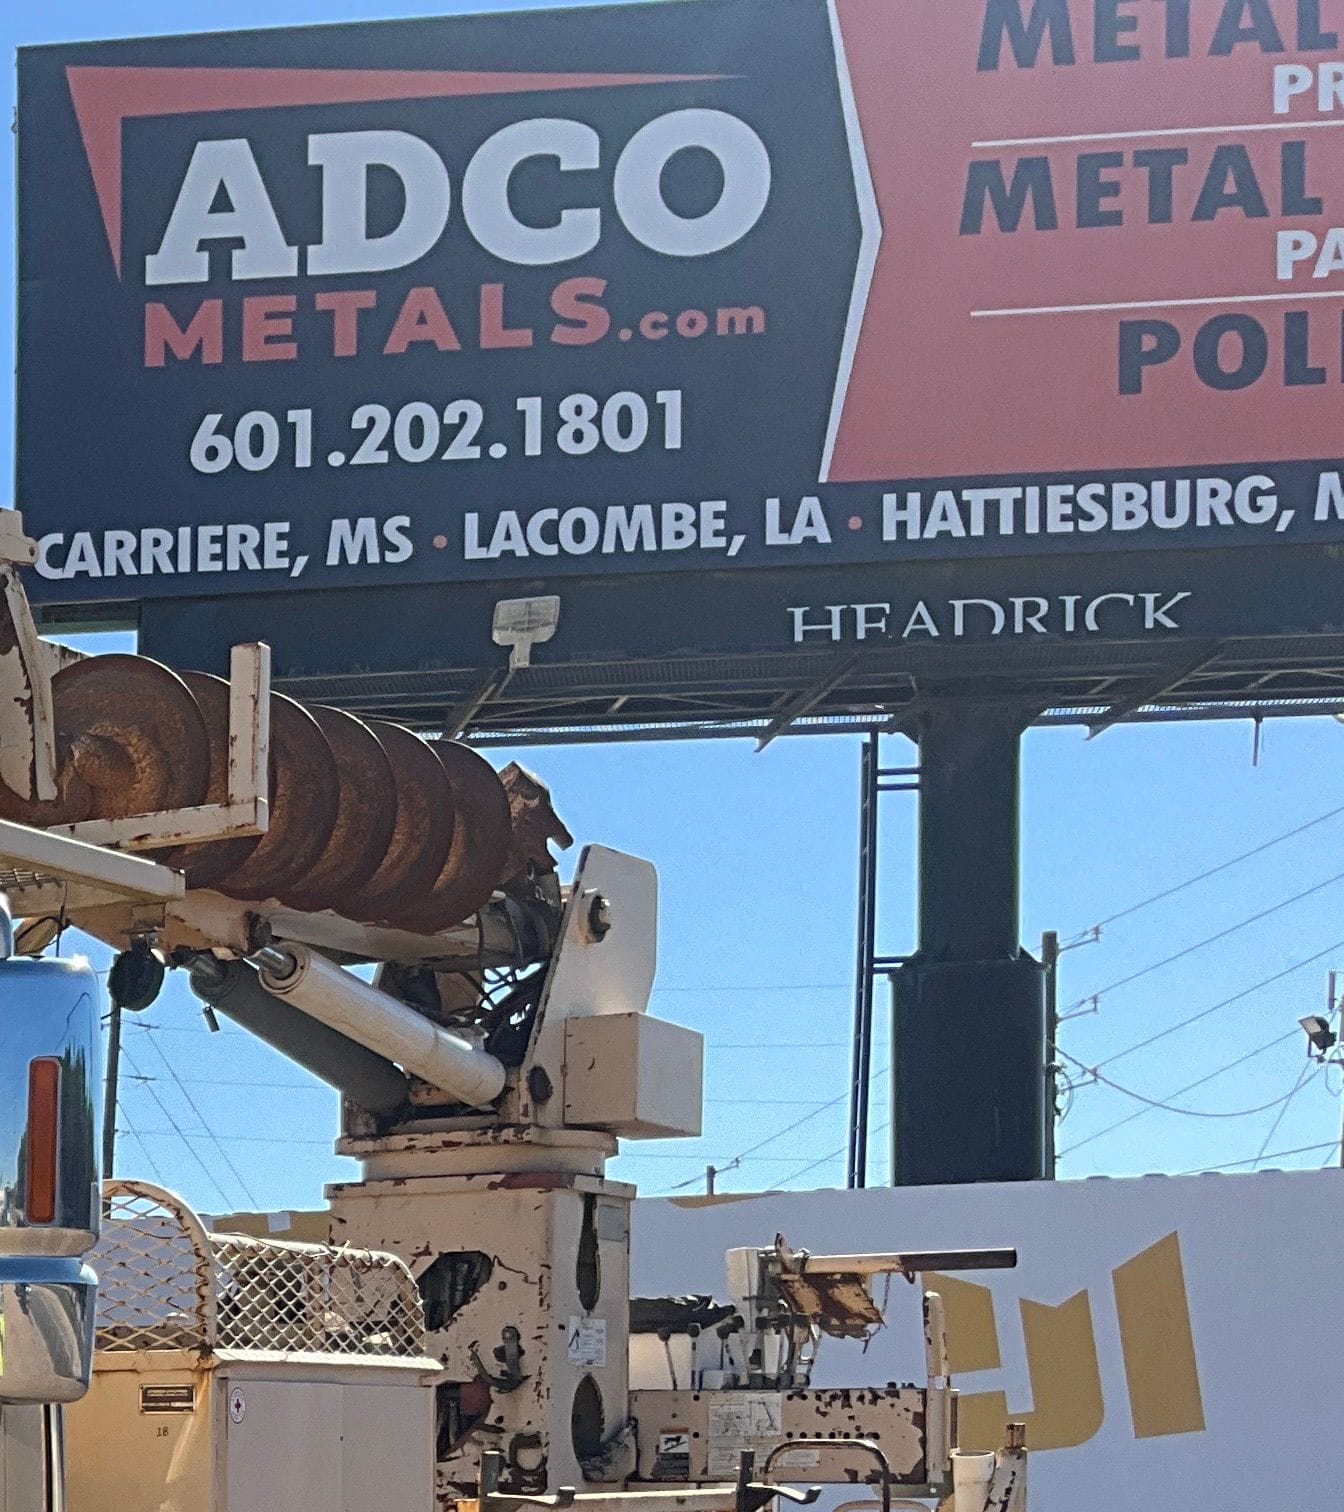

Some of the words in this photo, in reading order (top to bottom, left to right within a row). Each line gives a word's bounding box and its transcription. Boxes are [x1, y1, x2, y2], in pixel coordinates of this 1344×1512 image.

[144, 108, 772, 286] ADCO
[959, 140, 1324, 236] METAL
[143, 277, 766, 367] METALS.com
[1117, 309, 1344, 396] POL
[189, 389, 683, 475] 601.202.1801
[37, 521, 309, 580] CARRIERE,
[325, 515, 414, 567] MS
[463, 500, 746, 561] LACOMBE,
[764, 496, 833, 546] LA
[881, 474, 1296, 542] HATTIESBURG,
